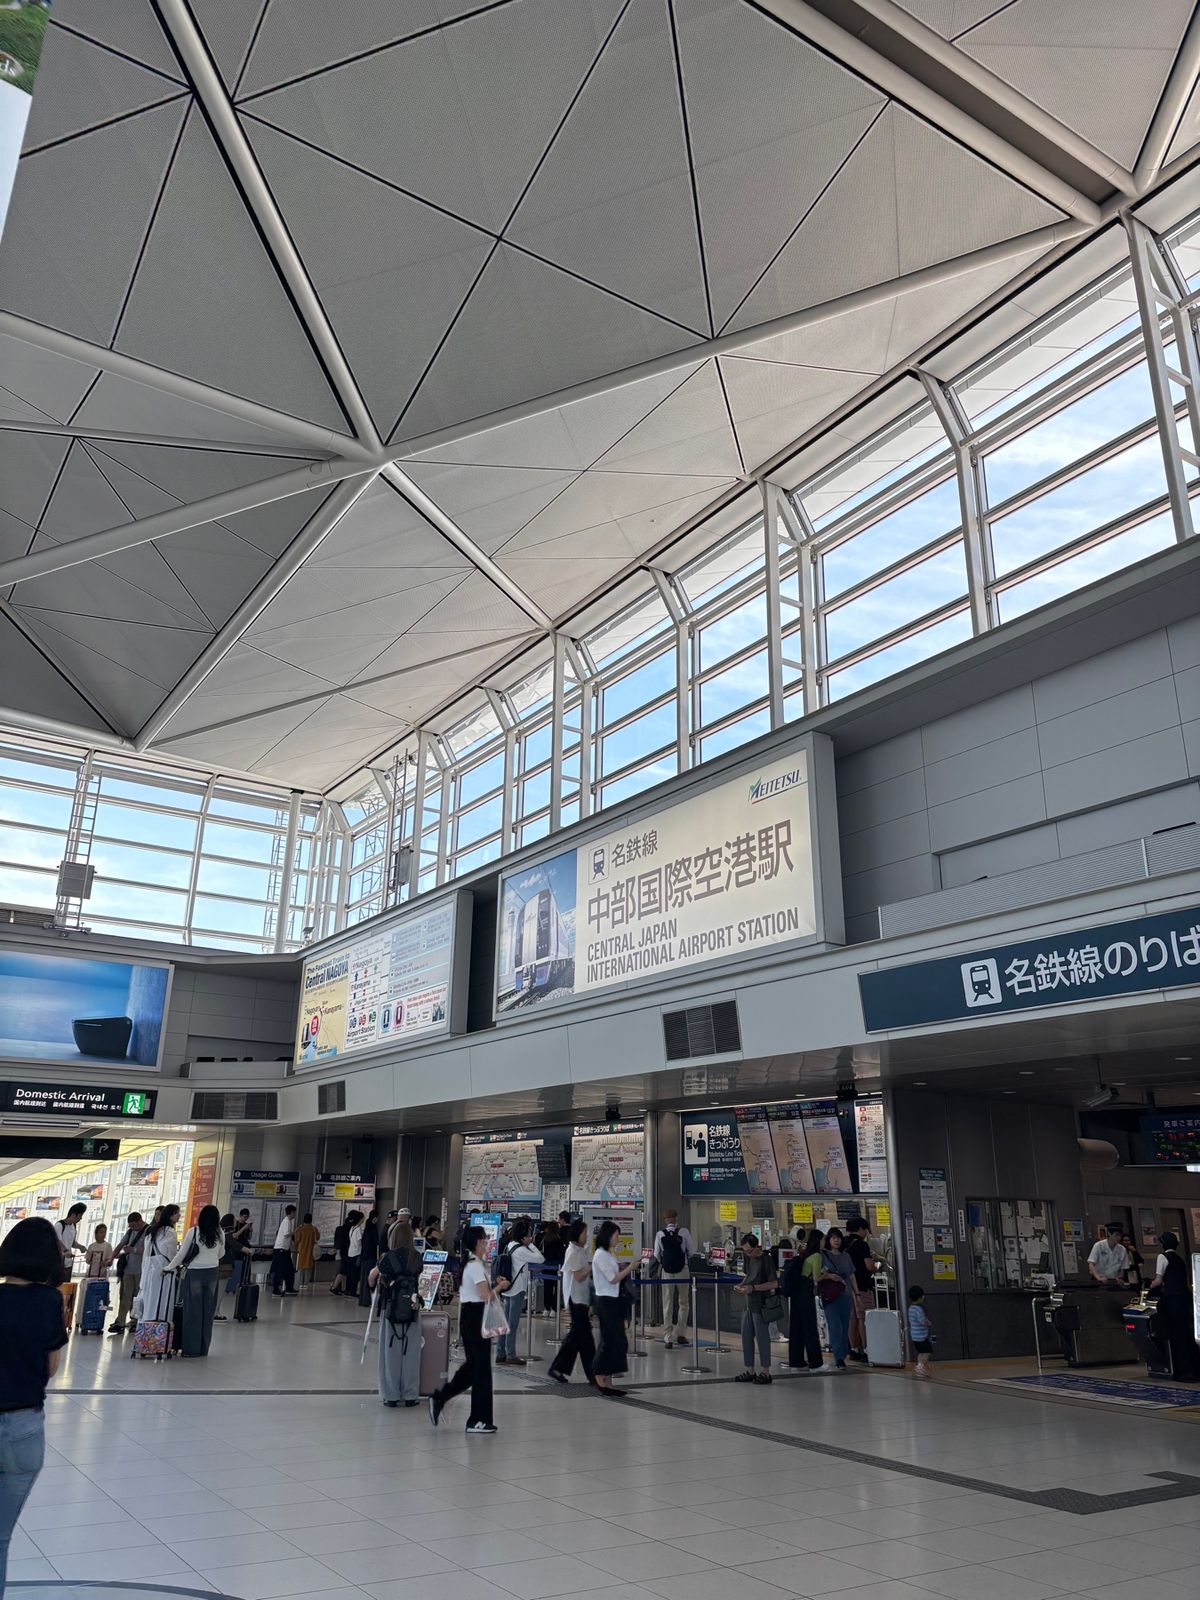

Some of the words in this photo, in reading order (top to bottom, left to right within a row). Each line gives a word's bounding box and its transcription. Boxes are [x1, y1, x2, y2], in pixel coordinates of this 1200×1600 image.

[748, 769, 800, 802] MEITETSU
[611, 829, 658, 868] 名鉄線
[587, 819, 794, 934] 中部国際空港駅
[587, 932, 635, 962] CENTRAL
[638, 918, 677, 948] JAPAN
[587, 943, 675, 983] INTERNATIONAL
[678, 925, 734, 960] AIRPORT
[738, 907, 799, 944] STATION
[305, 969, 326, 989] Central
[326, 960, 349, 982] NAGOYA
[16, 1089, 66, 1100] Domestic
[68, 1092, 105, 1102] Arrival
